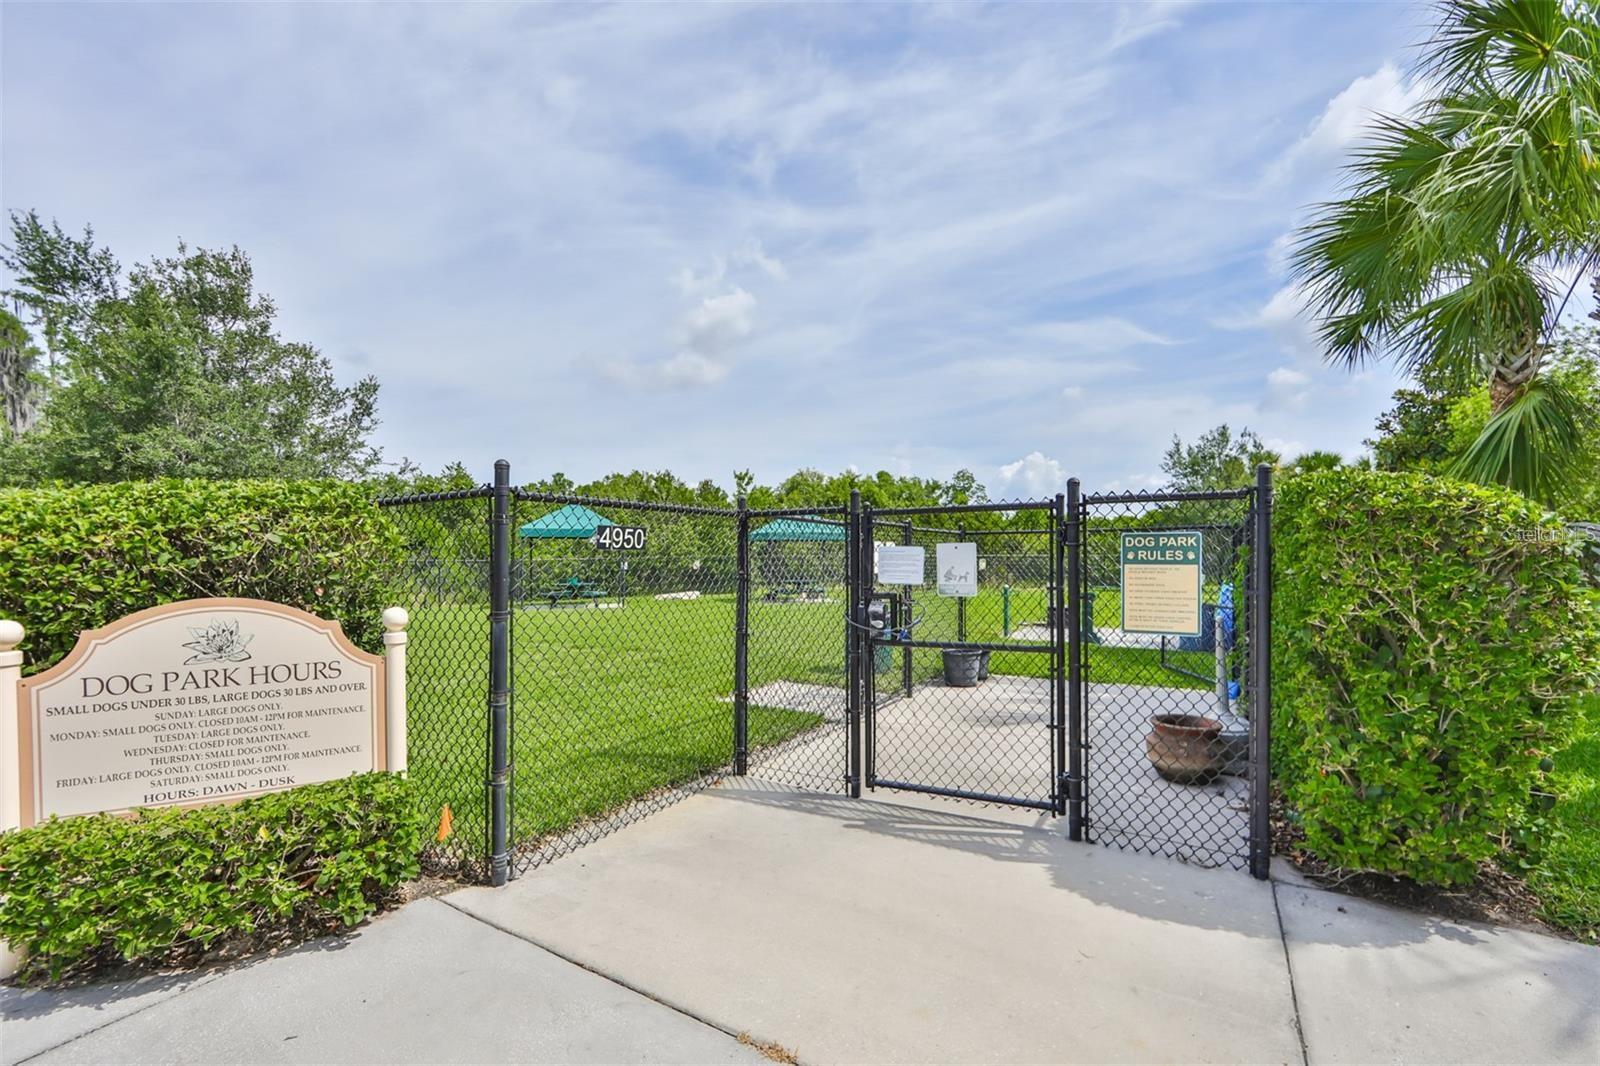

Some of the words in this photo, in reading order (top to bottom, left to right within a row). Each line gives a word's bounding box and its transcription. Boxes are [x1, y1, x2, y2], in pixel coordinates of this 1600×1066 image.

[599, 527, 644, 549] 4950
[1125, 537, 1155, 547] DOG
[1159, 536, 1198, 547] PARK
[1138, 550, 1184, 561] RULES
[81, 673, 153, 698] DOG
[161, 667, 241, 692] PARK
[248, 660, 342, 686] HOURS
[46, 704, 90, 717] SMALL
[92, 701, 128, 713] DOGS
[130, 697, 172, 710] UNDER
[175, 697, 186, 706] 30
[188, 695, 211, 705] LBS,
[213, 692, 249, 703] LARGE
[251, 689, 282, 700] DOGS
[284, 688, 294, 697] 30
[295, 686, 313, 696] LBS
[315, 685, 338, 695] AND
[339, 682, 368, 692] OVER.
[154, 709, 197, 721] SUNDAY:
[198, 706, 230, 717] LARGE
[230, 704, 256, 715] DOGS
[50, 730, 102, 743] MONDAY:
[102, 726, 138, 738] SMALL
[138, 723, 167, 734] DOGS
[198, 717, 234, 728] CLOSED
[235, 714, 259, 725] 10AM
[265, 712, 286, 722] 12PM
[287, 710, 304, 720] FOR
[153, 731, 200, 744] TUESDAY:
[201, 728, 232, 739] LARGE
[233, 726, 259, 736] DOGS
[123, 743, 188, 758] WEDNESDAY:
[188, 739, 225, 751] CLOSED
[226, 737, 244, 747] FOR
[149, 752, 204, 766] THURSDAY:
[204, 749, 236, 760] SMALL
[237, 746, 263, 757] DOGS
[56, 775, 98, 789] FRIDAY:
[99, 772, 133, 784] LARGE
[134, 768, 163, 779] DOGS
[194, 760, 230, 772] CLOSED
[231, 757, 255, 768] 10AM
[261, 754, 282, 764] 12PM
[283, 752, 300, 761] FOR
[149, 774, 204, 788] SATURDAY:
[205, 771, 236, 781] SMALL
[237, 768, 263, 779] DOGS
[143, 787, 199, 803] HOURS:
[202, 781, 248, 796] DAWN
[258, 775, 296, 788] DUSK
